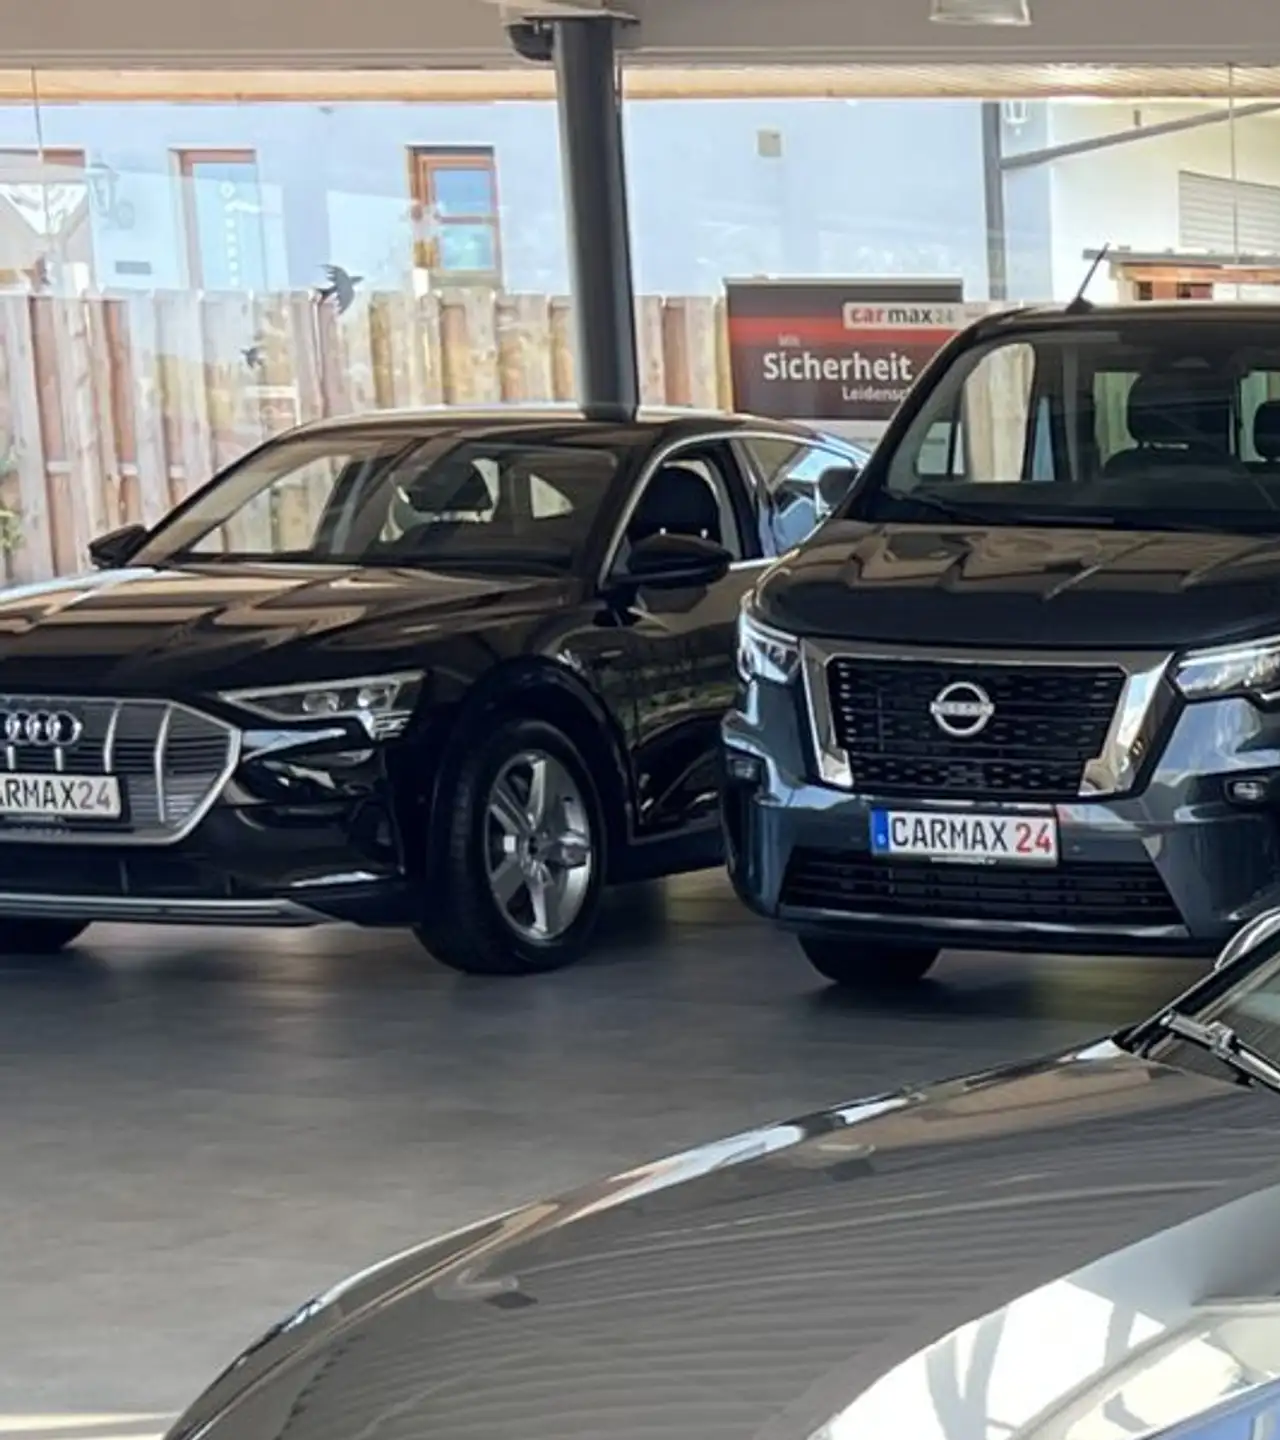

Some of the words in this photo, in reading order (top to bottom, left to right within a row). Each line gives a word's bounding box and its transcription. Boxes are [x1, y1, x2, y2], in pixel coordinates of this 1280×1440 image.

[763, 351, 913, 381] Sicherheit
[841, 384, 907, 402] Leidensc
[890, 816, 1009, 853] CARMAX
[1014, 821, 1053, 854] 24
